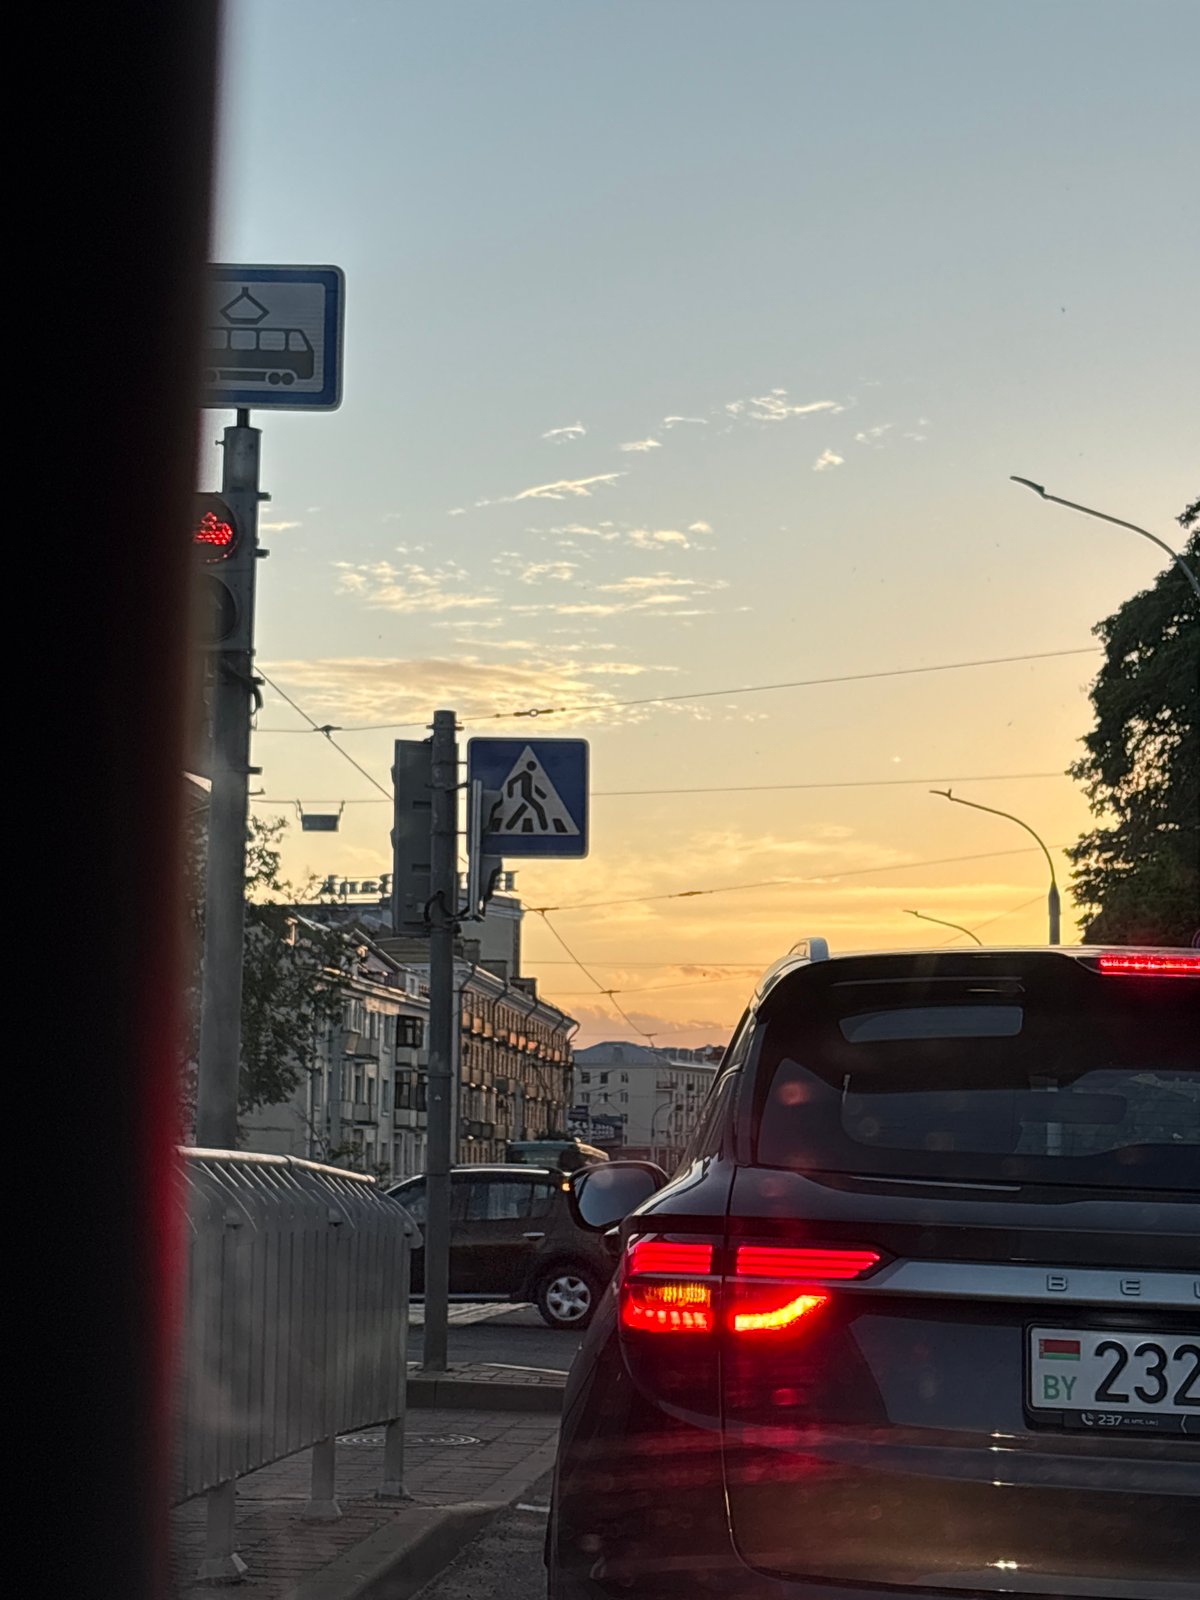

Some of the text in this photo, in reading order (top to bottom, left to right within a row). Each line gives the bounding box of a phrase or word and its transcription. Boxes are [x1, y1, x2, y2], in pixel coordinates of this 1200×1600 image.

[1094, 1340, 1200, 1407] 232
[1043, 1375, 1077, 1400] BY
[1098, 1414, 1122, 1426] 237
